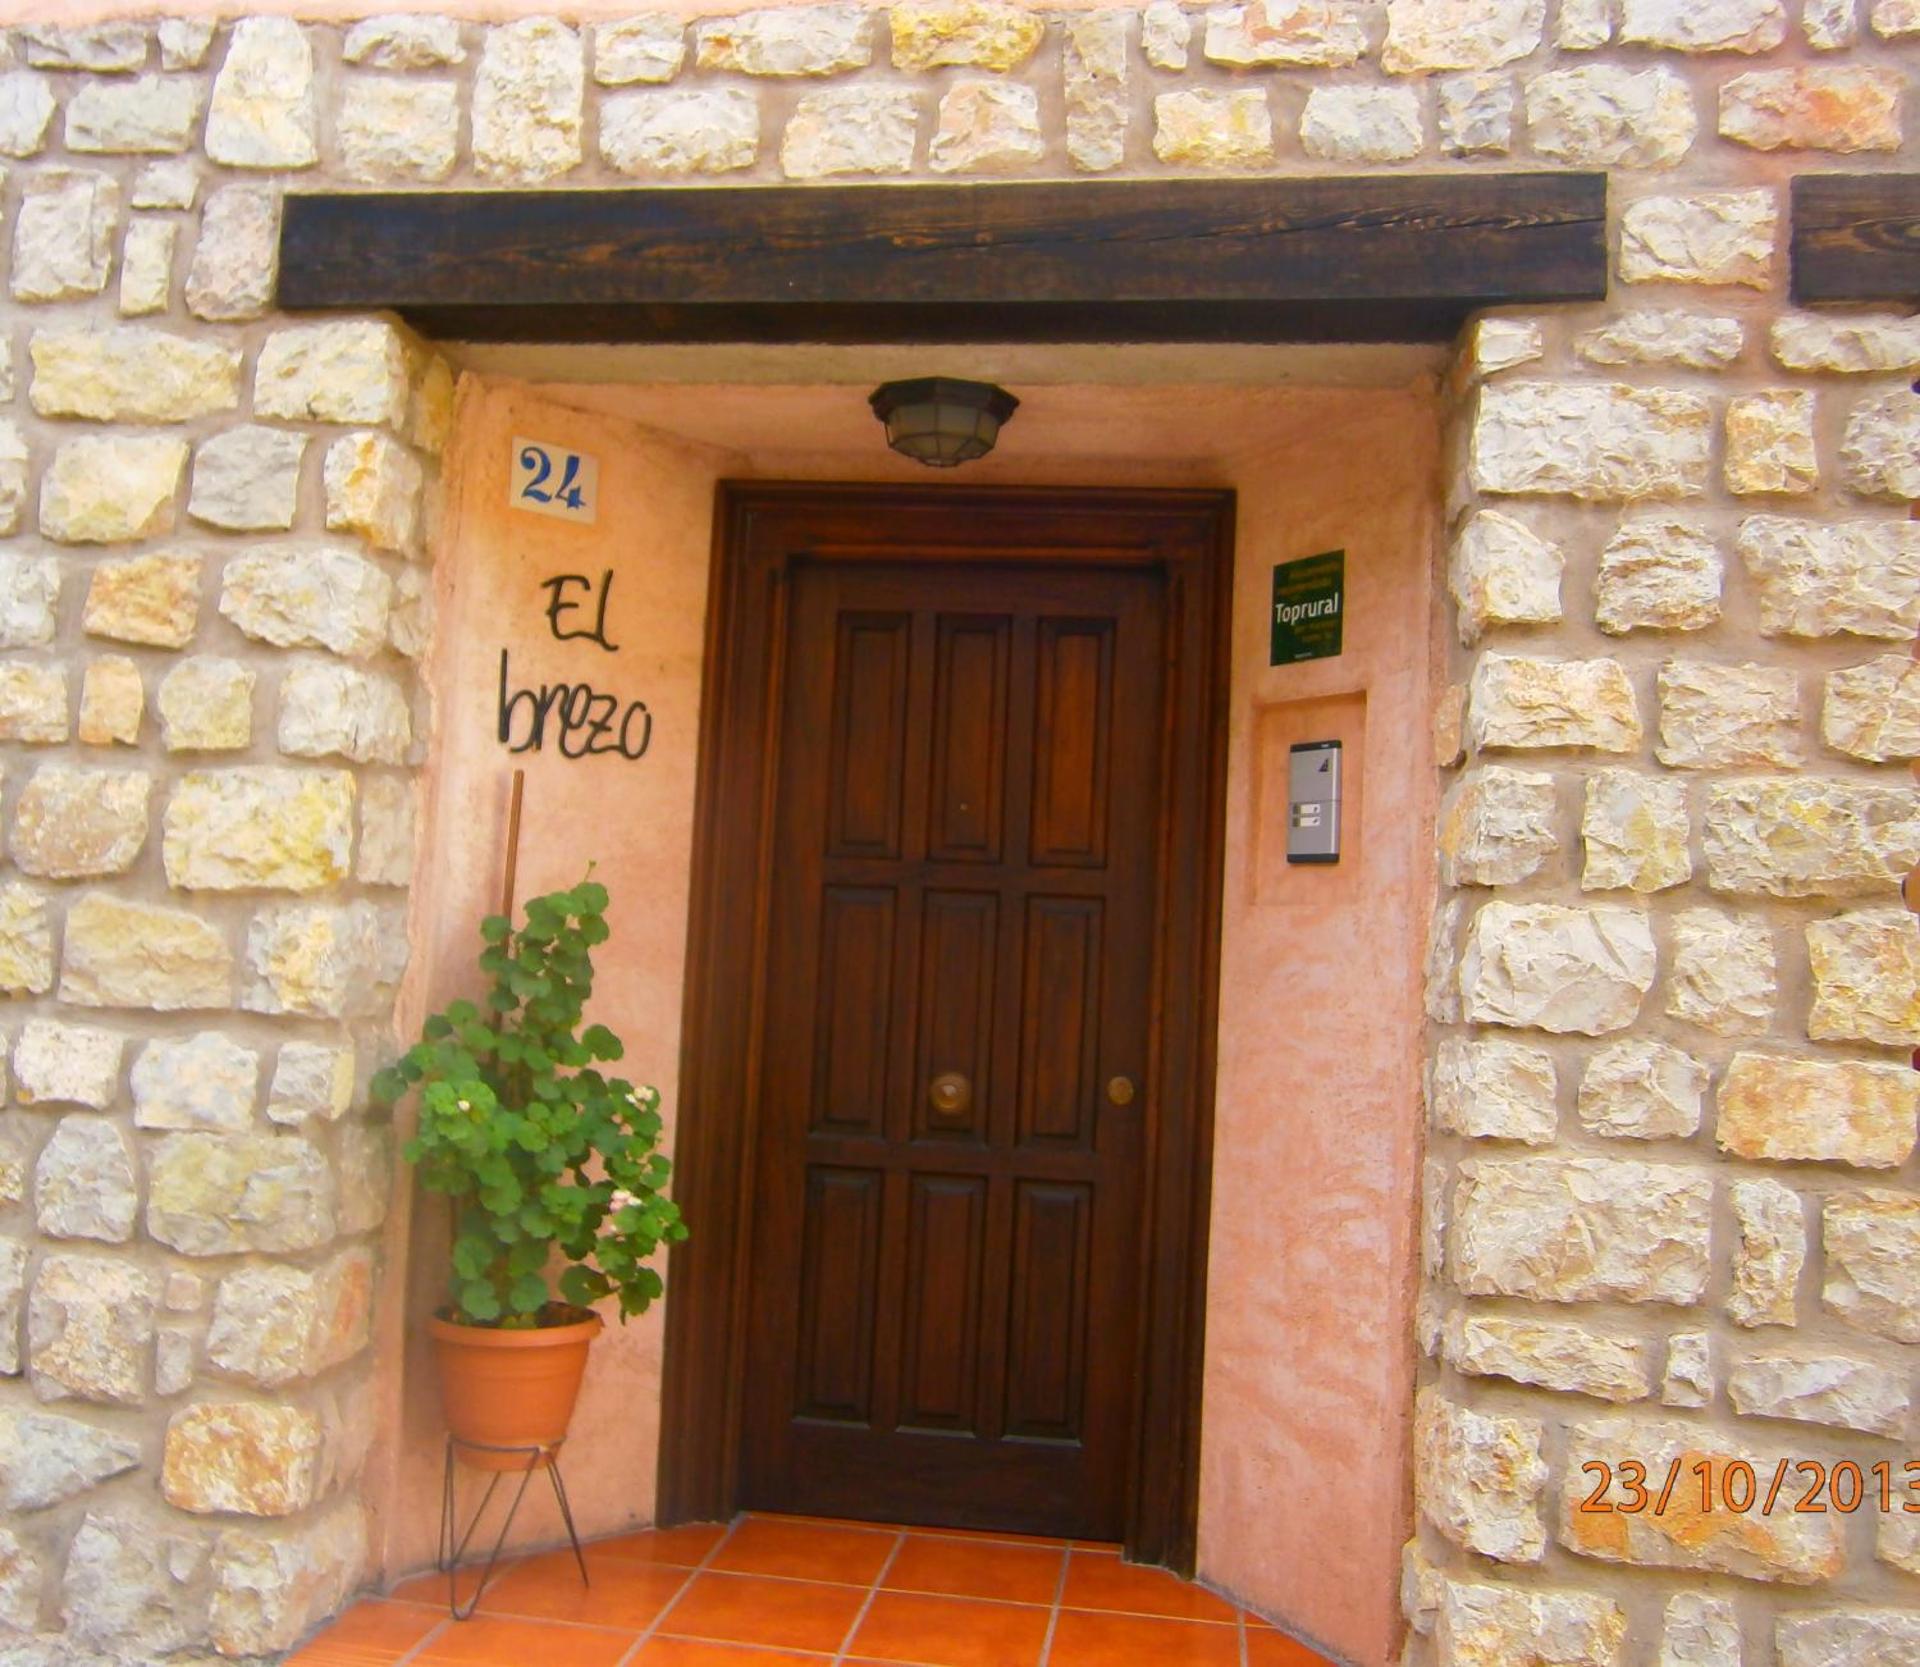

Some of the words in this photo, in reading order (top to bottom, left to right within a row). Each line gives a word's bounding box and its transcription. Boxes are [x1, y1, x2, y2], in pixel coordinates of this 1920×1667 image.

[519, 446, 586, 509] 24
[540, 568, 620, 651] El
[1275, 592, 1339, 626] Toprural
[498, 648, 652, 760] brezo
